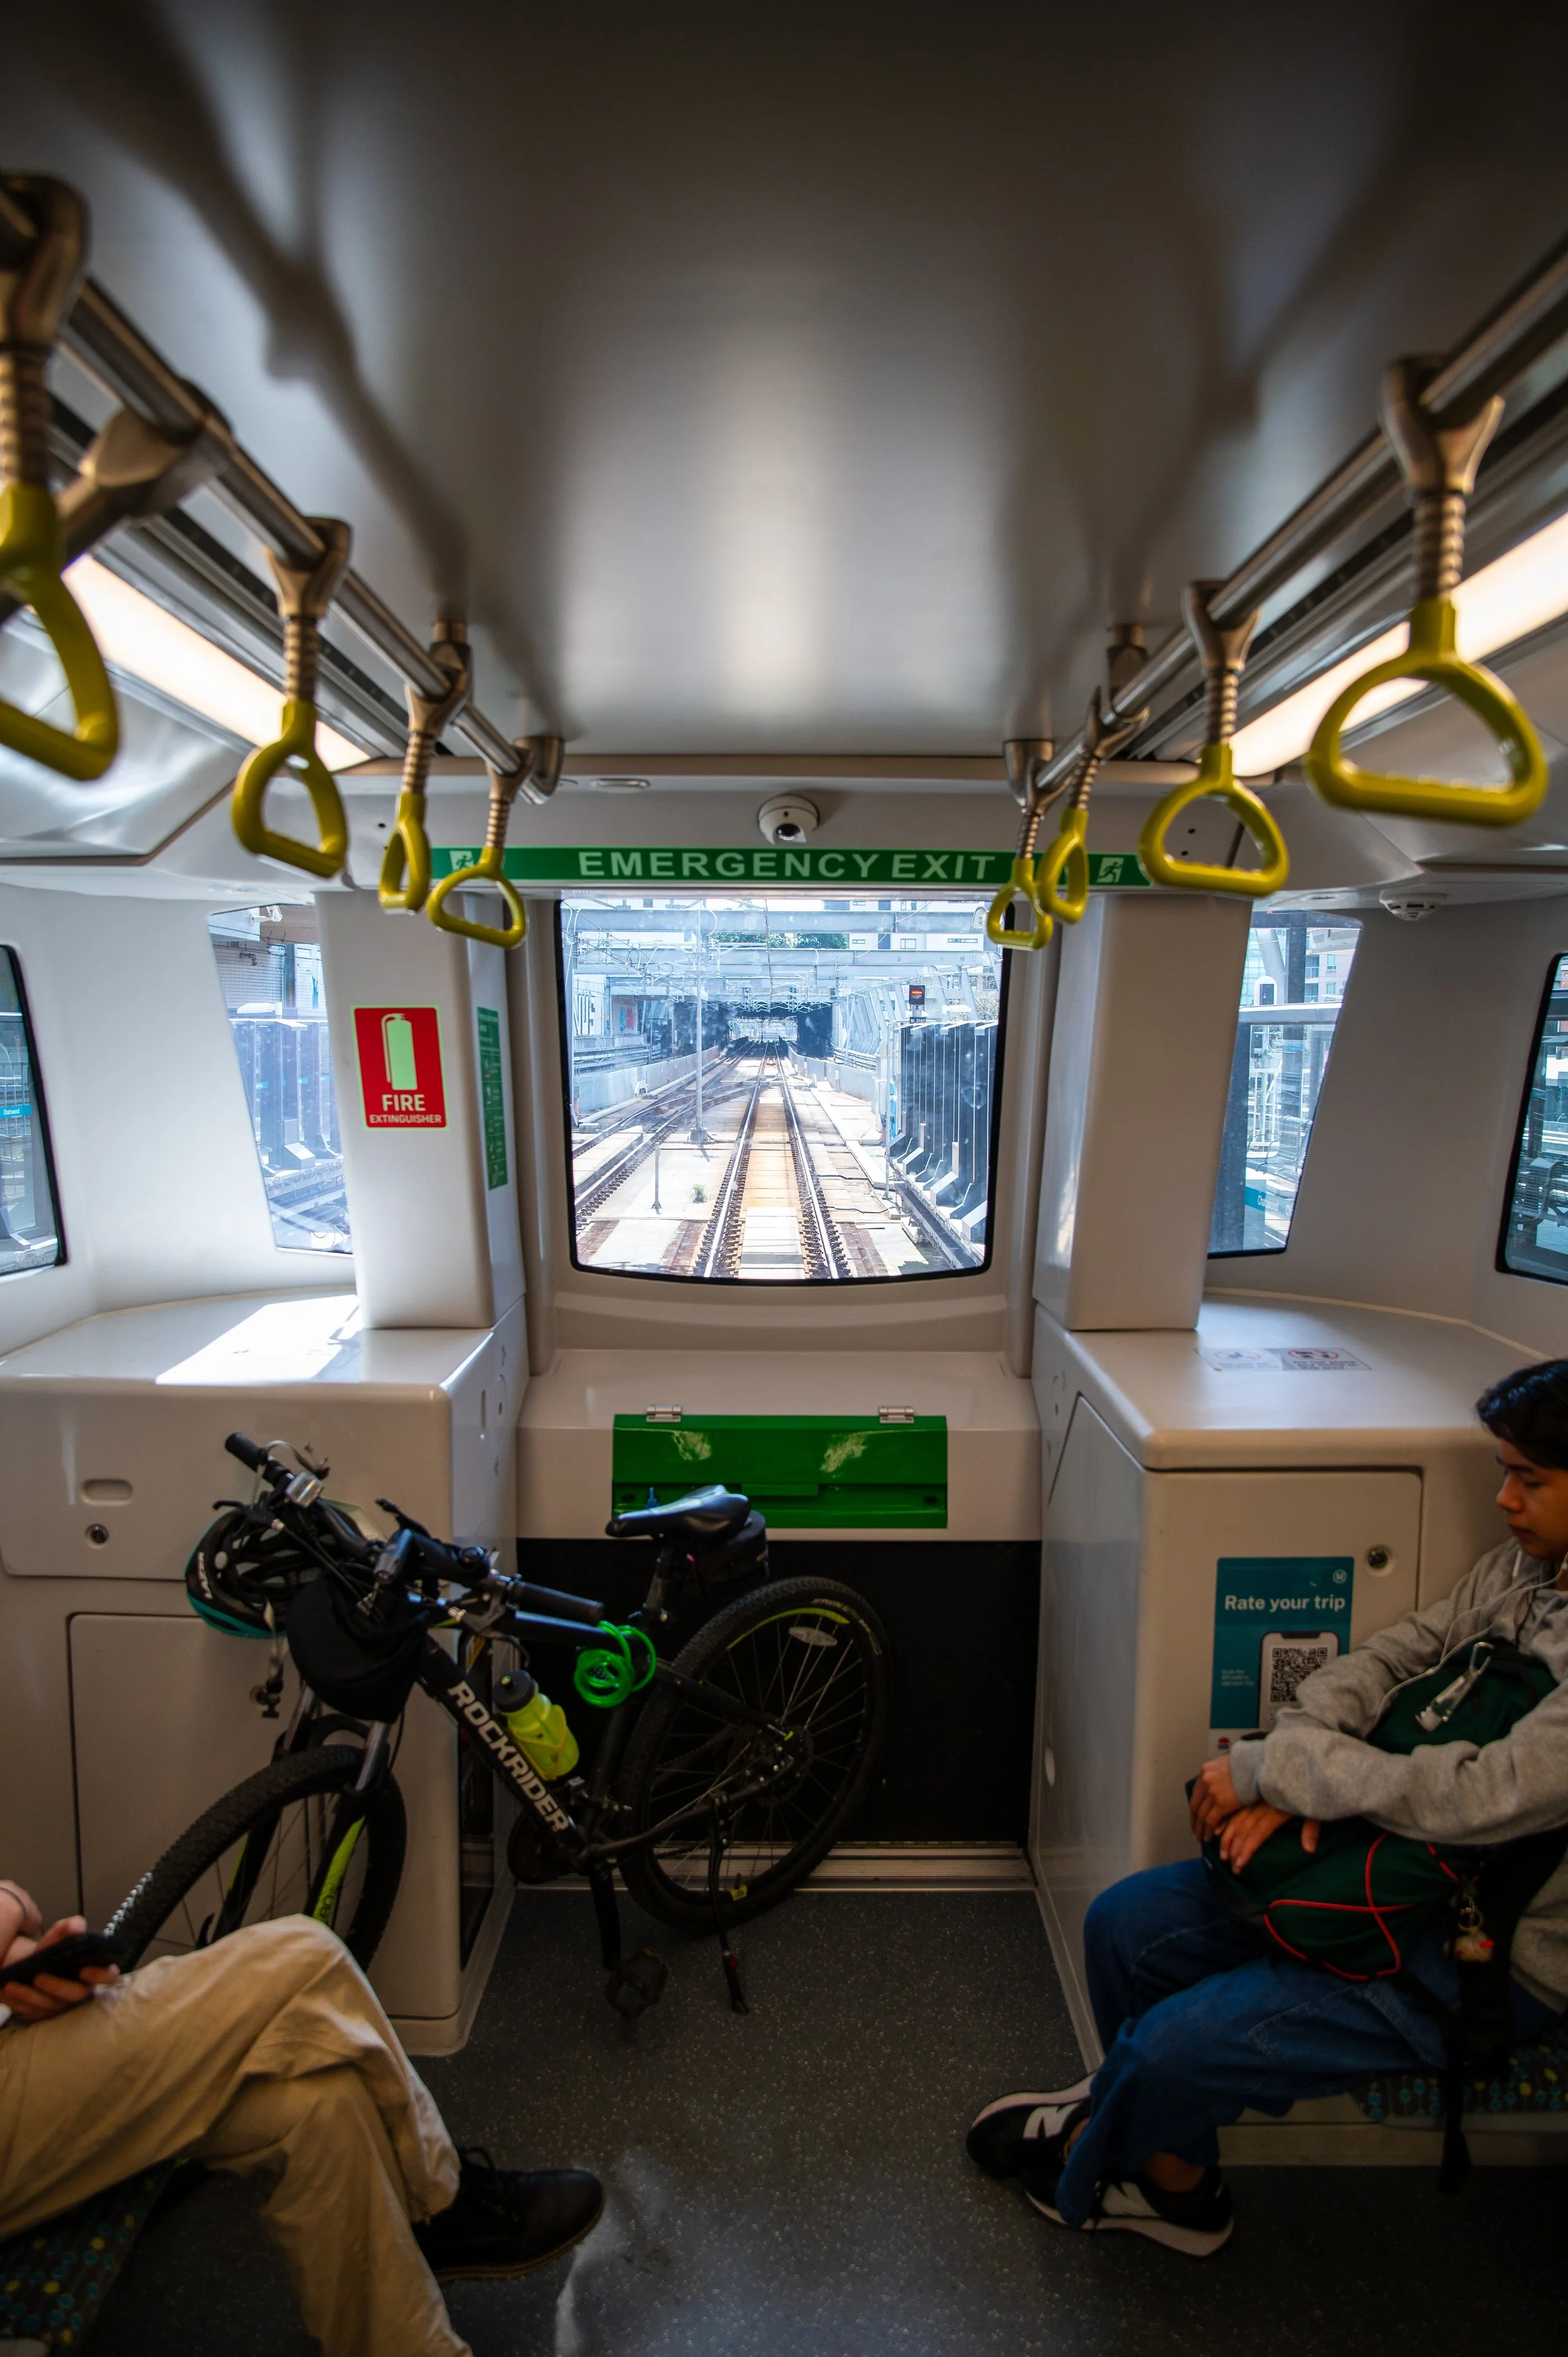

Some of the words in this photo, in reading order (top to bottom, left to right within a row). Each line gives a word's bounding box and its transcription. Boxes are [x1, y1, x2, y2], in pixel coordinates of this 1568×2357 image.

[578, 851, 879, 878] EMERGENCY
[891, 854, 995, 880] EXIT
[382, 1094, 426, 1112] FIRE
[369, 1114, 442, 1124] EXTINGUISHER
[1224, 1595, 1266, 1610] Rate
[1269, 1597, 1310, 1613] your
[1314, 1594, 1346, 1612] trip
[447, 1680, 570, 1833] ROCKRIDER
